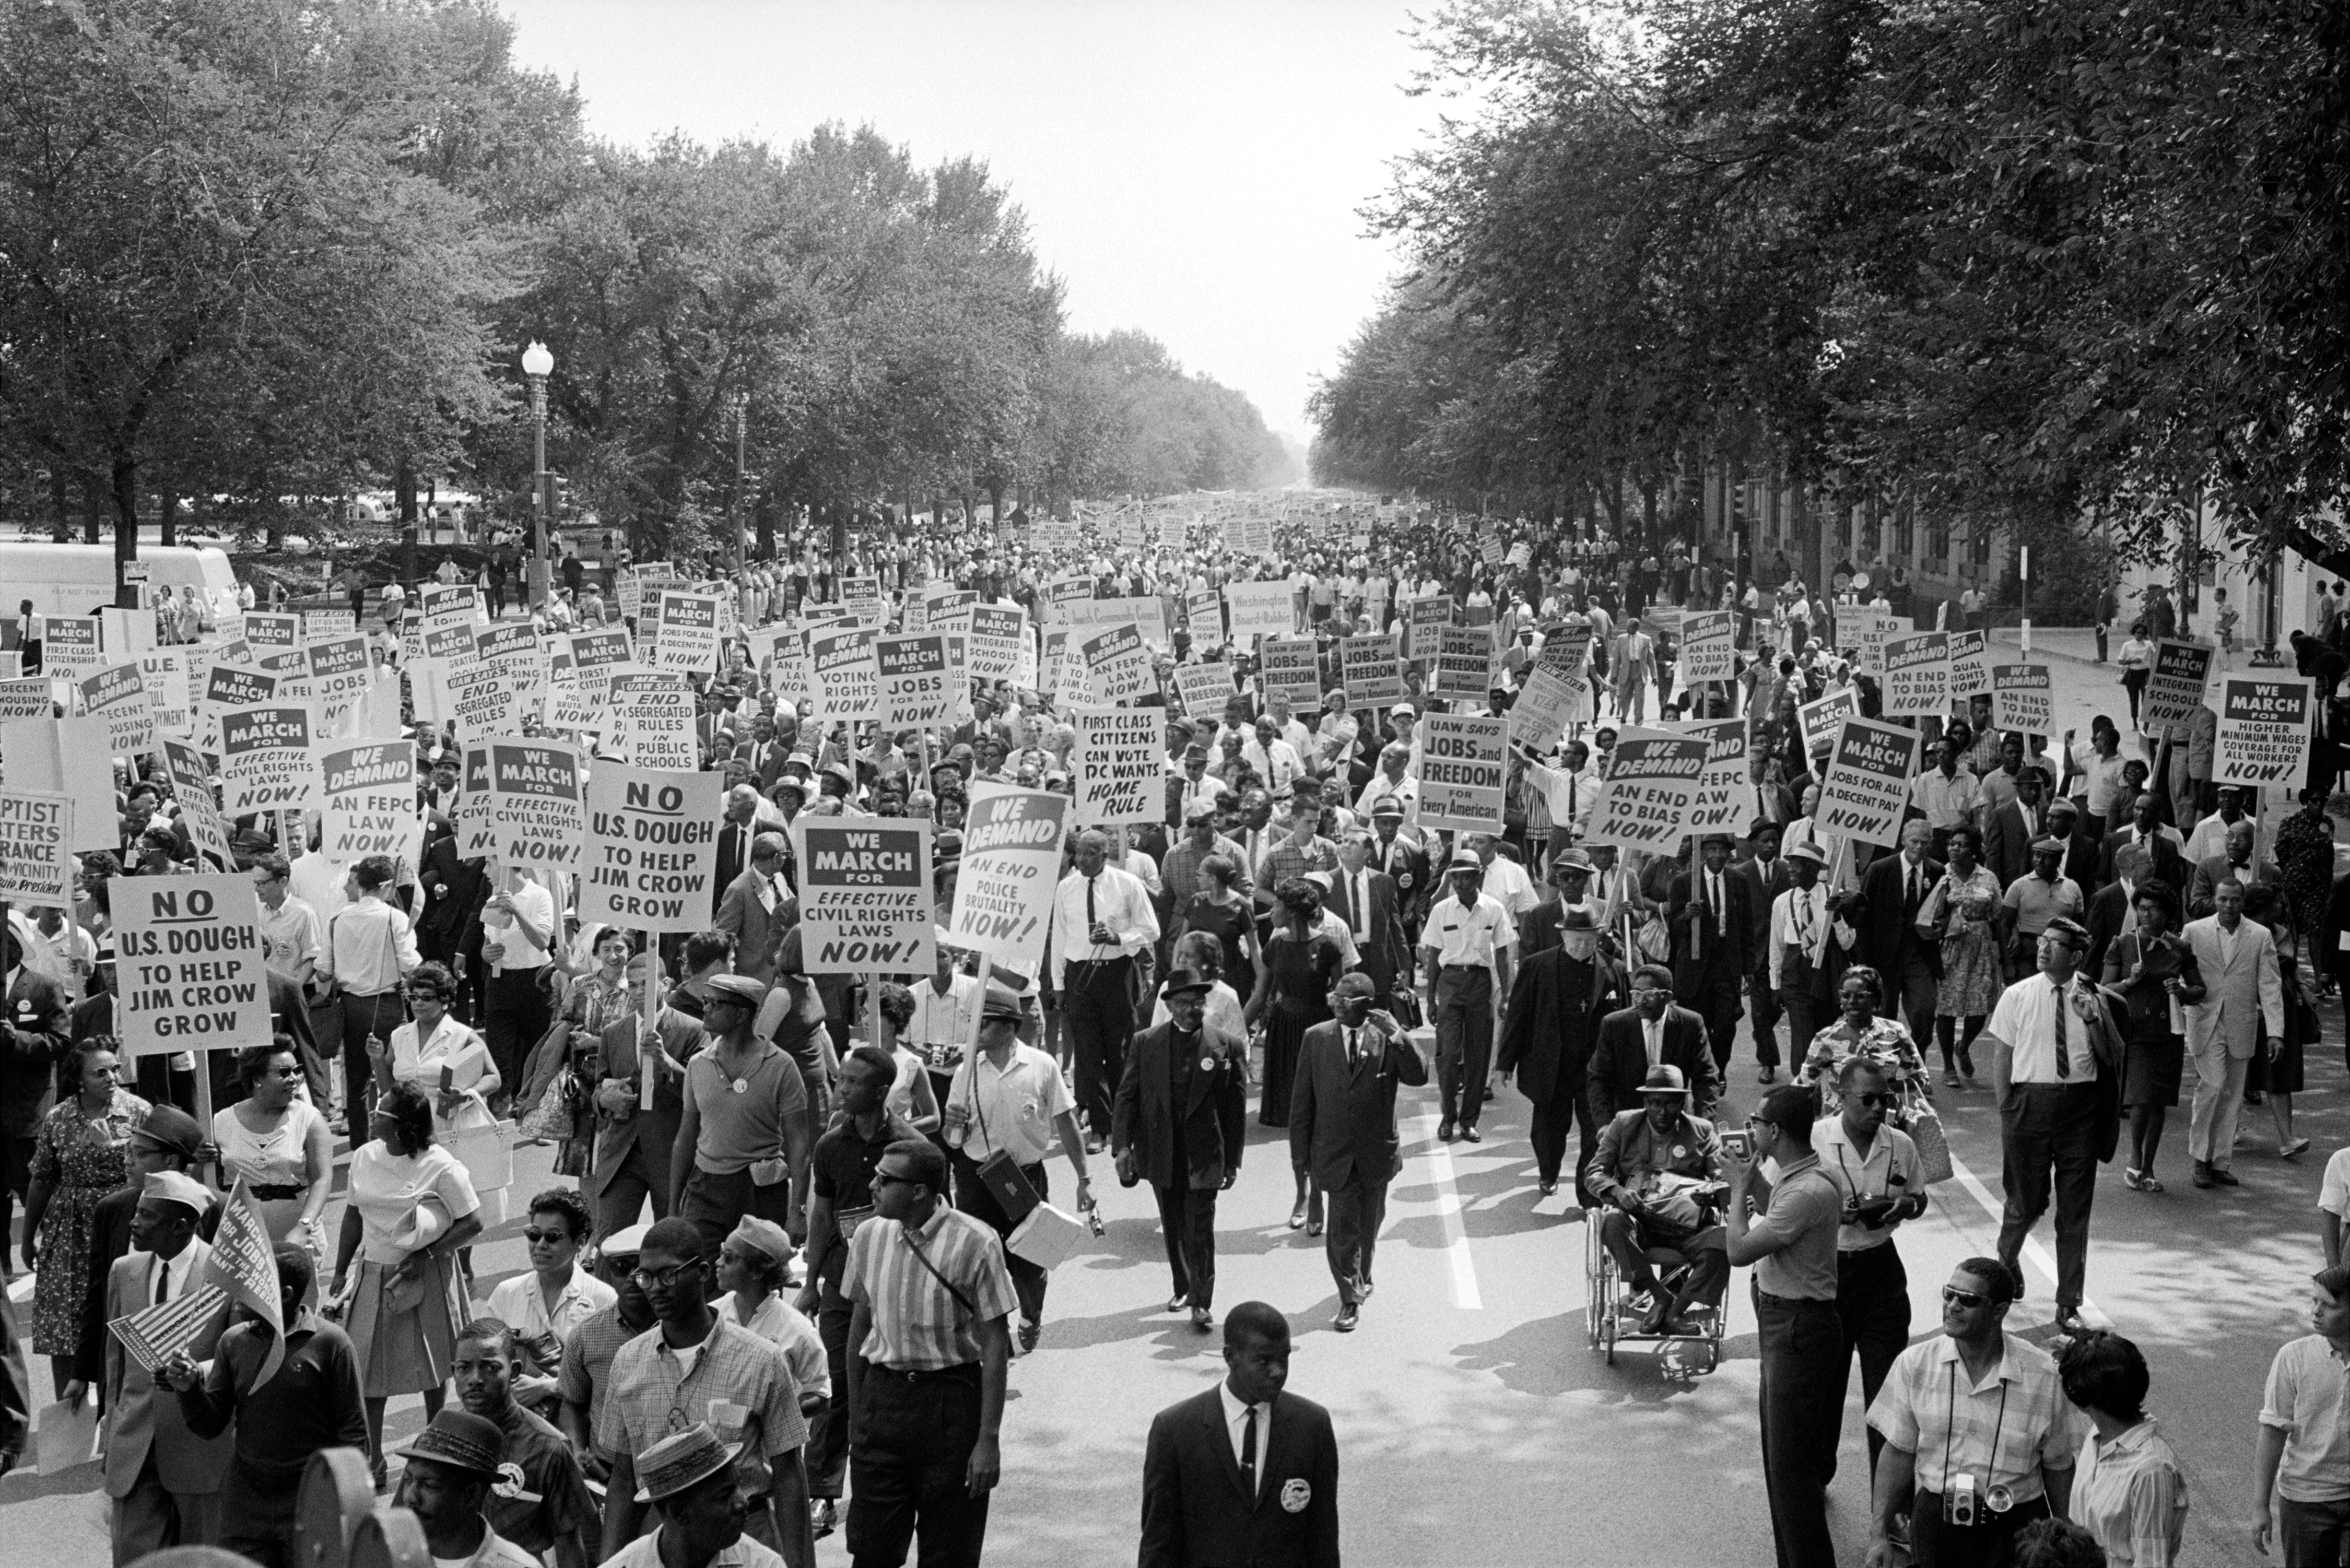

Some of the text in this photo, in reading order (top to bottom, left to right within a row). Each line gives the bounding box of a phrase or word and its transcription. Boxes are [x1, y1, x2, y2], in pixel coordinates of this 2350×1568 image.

[1233, 594, 1288, 609] Washington
[1235, 611, 1290, 625] Board Rabbis
[900, 642, 919, 651] WE
[2179, 649, 2192, 658] WE
[884, 650, 938, 666] MARCH
[2161, 655, 2203, 672] MARCH
[2011, 666, 2030, 675] WE
[888, 677, 942, 694] JOBS
[1998, 675, 2049, 687] DEMAND
[2151, 677, 2202, 693] INTEGRATED
[638, 694, 680, 704] END
[826, 685, 877, 697] RIGHTS
[2001, 692, 2049, 706] AN END
[2149, 690, 2199, 706] SCHOOLS
[2255, 685, 2278, 696] WE
[628, 706, 692, 717] SEGREGATED
[825, 698, 878, 713] NOW!
[2002, 702, 2049, 716] TO BIAS
[2231, 696, 2299, 712] MARCH
[252, 712, 277, 723] WE
[891, 703, 947, 723] NOW!
[2004, 713, 2049, 728] NOW!
[2149, 705, 2194, 722] NOW!
[638, 720, 683, 730] RULES
[1084, 715, 1151, 729] FIRST CLASS
[1431, 721, 1500, 736] UAW SAYS
[2239, 723, 2289, 733] HIGHER
[231, 723, 302, 742] MARCH
[1091, 731, 1156, 745] CITIZENS
[1871, 732, 1890, 746] WE
[2221, 730, 2306, 744] MINIMUM WAGES
[637, 743, 688, 753] PUBLIC
[1425, 737, 1501, 761] JOBS and
[1644, 742, 1681, 757] WE
[1844, 740, 1906, 767] MARCH
[2224, 741, 2277, 753] COVERAGE
[234, 751, 306, 768] EFFECTIVE
[352, 747, 383, 768] WE
[524, 751, 549, 764] WE
[635, 757, 691, 768] SCHOOLS
[1086, 750, 1149, 762] CAN VOTE
[2226, 750, 2297, 763] ALL WORKERS
[225, 763, 313, 780] CIVIL RIGHTS
[330, 762, 410, 787] DEMAND
[1112, 763, 1159, 778] WANTS
[1423, 762, 1500, 787] FREEDOM
[1615, 757, 1707, 776] DEMAND
[1860, 760, 1884, 772] FOR
[2225, 762, 2296, 781] NOW!
[250, 774, 289, 786] LAWS
[502, 764, 572, 786] MARCH
[1831, 771, 1902, 796] JOBS FOR ALL
[237, 785, 309, 808] NOW!
[526, 784, 554, 793] FOR
[626, 782, 683, 811] NO
[1087, 781, 1141, 803] HOME
[1449, 790, 1472, 798] FOR
[1612, 784, 1687, 807] AN END
[331, 796, 412, 812] AN FEPC
[506, 798, 576, 815] EFFECTIVE
[1102, 796, 1146, 816] RULE
[1420, 796, 1498, 819] Every American
[1826, 787, 1899, 812] A DECENT PAY
[991, 798, 1027, 822] WE
[1610, 800, 1681, 824] TO BIAS
[349, 816, 394, 830] LAW
[496, 811, 583, 831] CIVIL RIGHTS
[593, 812, 713, 844] U.S. DOUGH
[1827, 807, 1891, 835] NOW!
[522, 826, 562, 840] LAWS
[967, 819, 1055, 848] DEMAND
[1601, 819, 1676, 843] NOW!
[337, 834, 407, 852] NOW!
[846, 833, 879, 848] WE
[510, 840, 580, 864] NOW!
[604, 846, 696, 870] TO HELP
[816, 852, 911, 870] MARCH
[970, 858, 1038, 879] AN END
[14, 862, 60, 880] VICINITY
[846, 874, 883, 883] FOR
[19, 879, 63, 895] President
[590, 867, 704, 893] JIM CROW
[977, 880, 1018, 899] POLICE
[152, 890, 213, 917] NO
[609, 894, 683, 918] GROW
[818, 892, 917, 906] EFFECTIVE
[965, 894, 1027, 916] BRUTALITY
[806, 908, 925, 922] CIVIL RIGHTS
[839, 925, 892, 937] LAWS
[961, 911, 1037, 943] NOW!
[122, 926, 255, 956] U.S. DOUGH
[820, 940, 919, 963] NOW!
[139, 961, 241, 984] TO HELP
[130, 983, 255, 1011] JIM CROW
[155, 1011, 236, 1036] GROW
